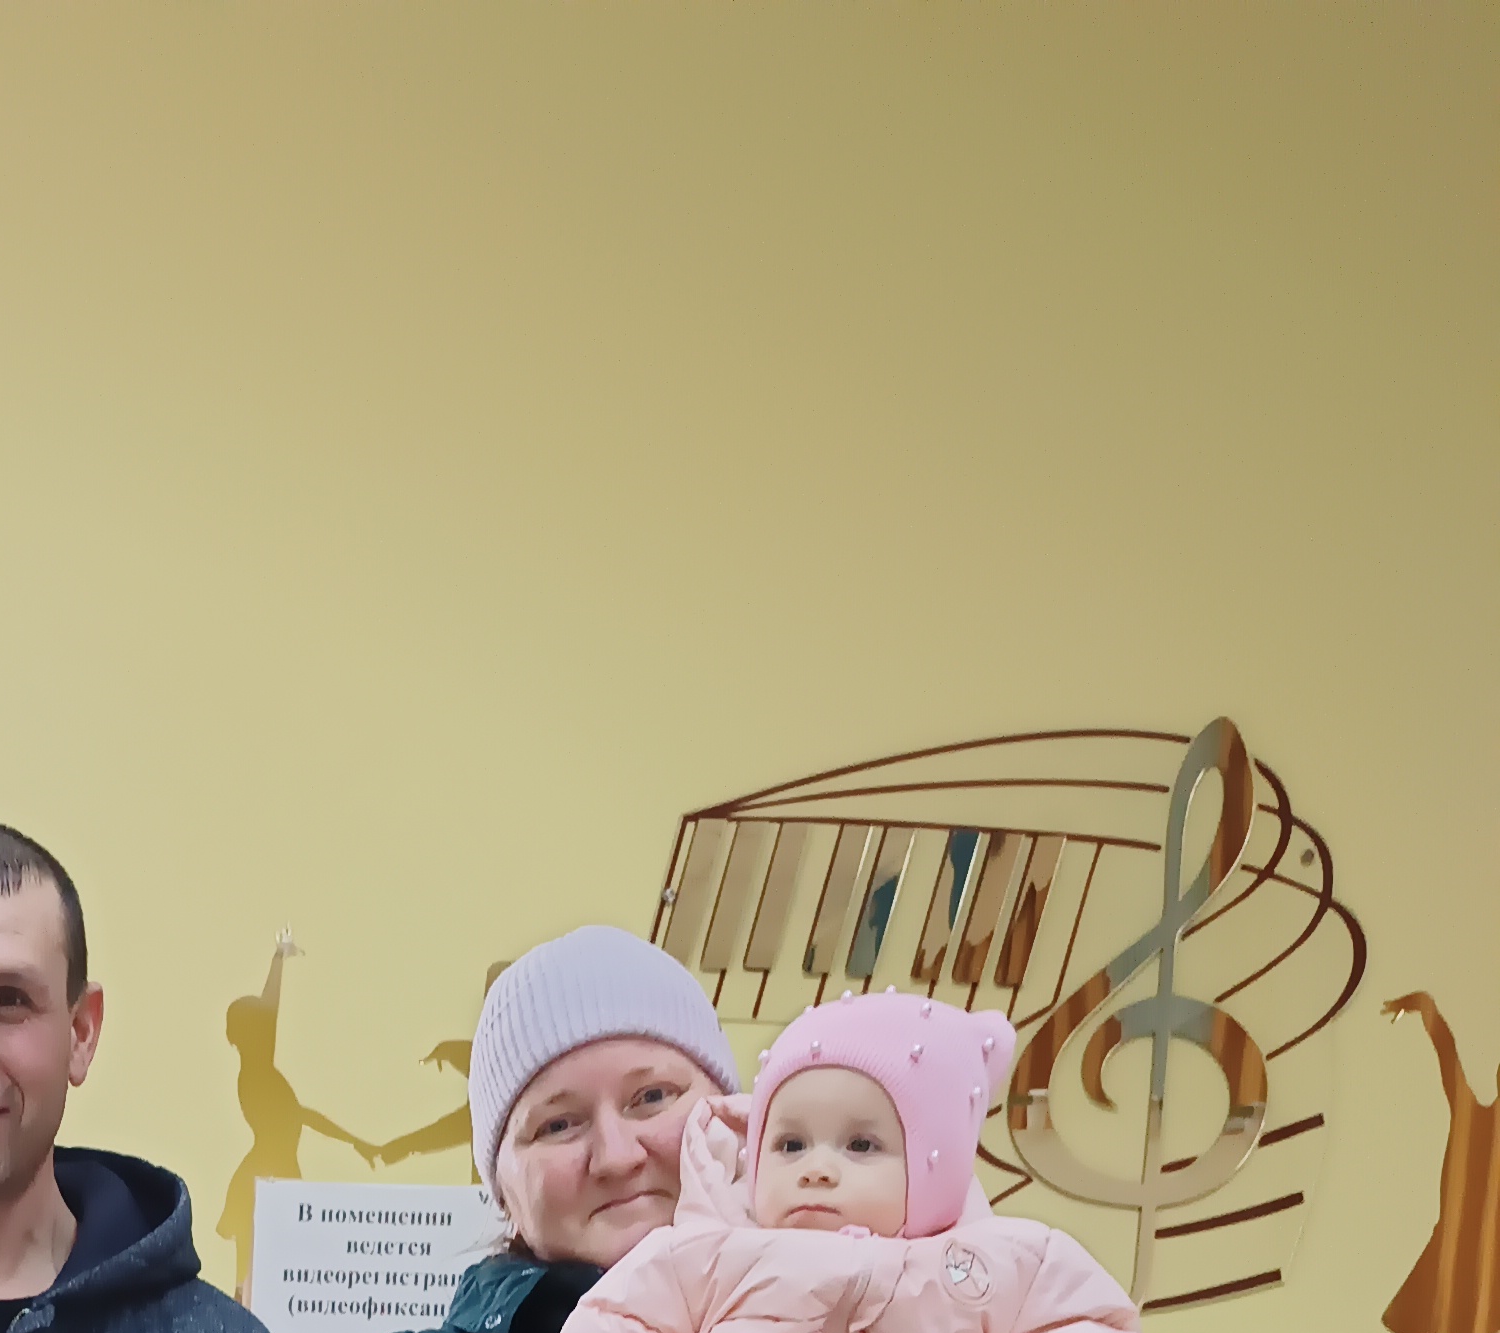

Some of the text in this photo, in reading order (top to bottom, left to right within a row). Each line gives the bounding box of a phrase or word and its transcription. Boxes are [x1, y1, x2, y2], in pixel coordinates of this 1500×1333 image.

[299, 1203, 453, 1227] В помещении
[347, 1240, 432, 1256] ведется
[288, 1295, 446, 1320] (видеофиксац
